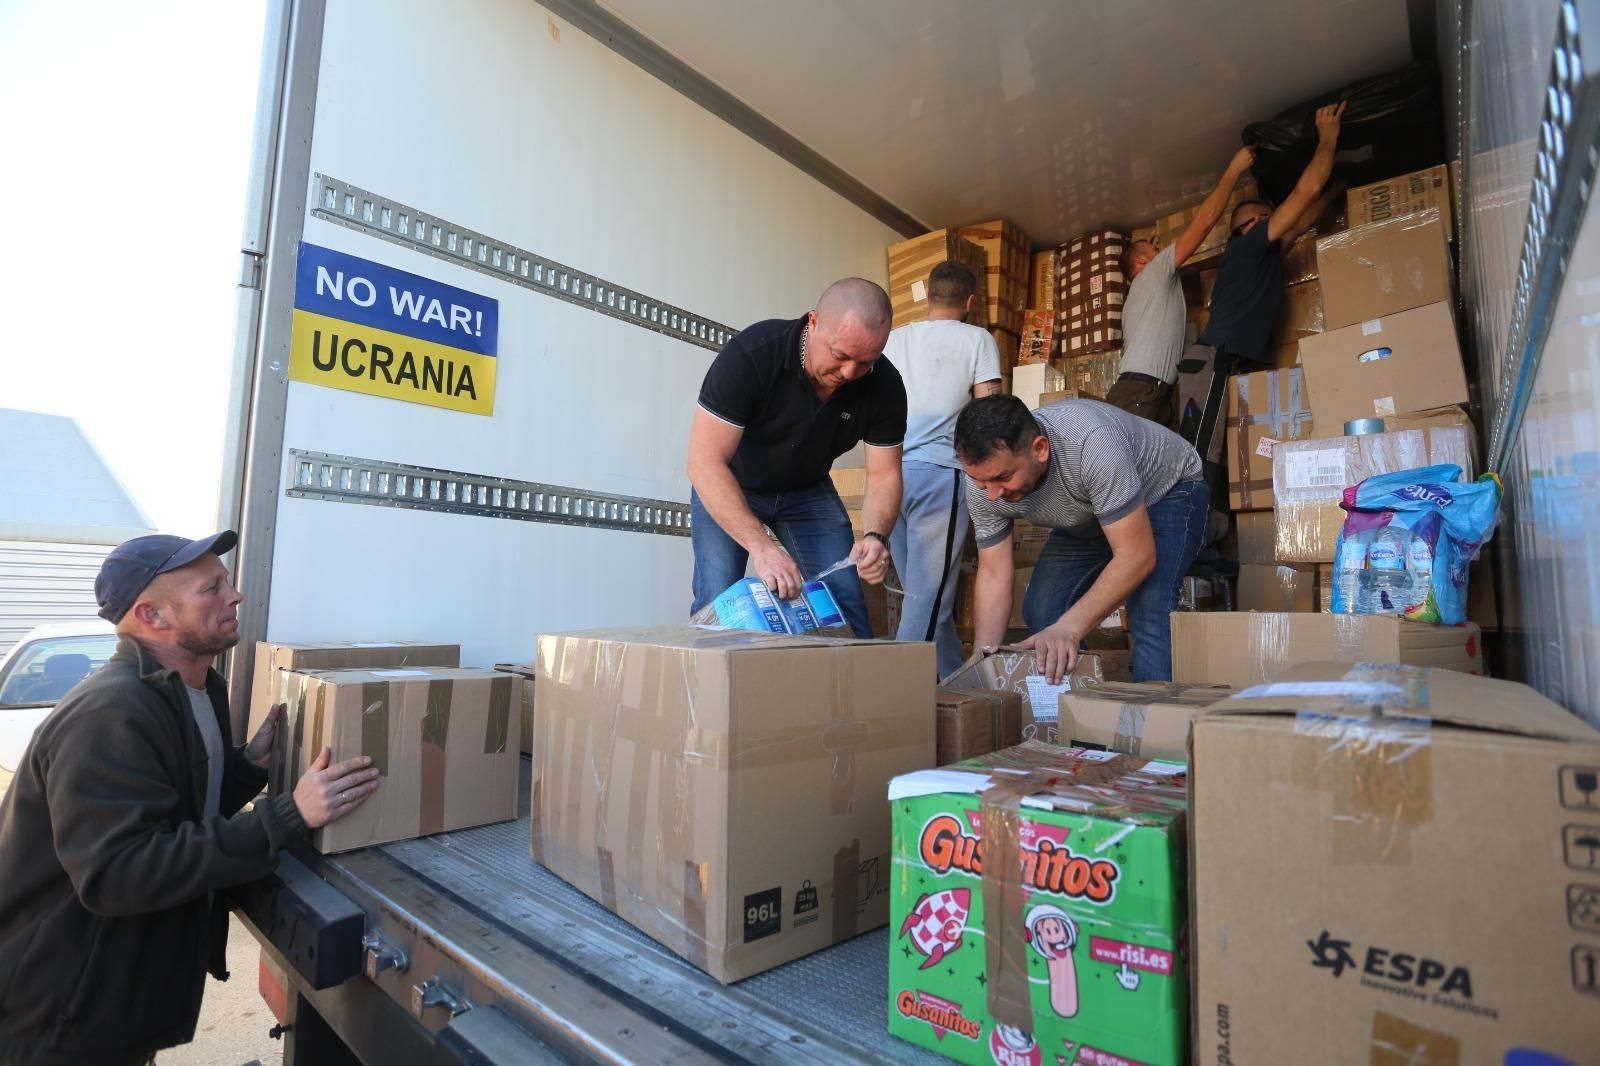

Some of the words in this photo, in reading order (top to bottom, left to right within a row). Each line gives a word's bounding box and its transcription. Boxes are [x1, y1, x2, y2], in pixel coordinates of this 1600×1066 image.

[316, 265, 377, 307] NO
[389, 286, 483, 337] WAR!
[312, 330, 477, 401] UCRANIA
[747, 902, 778, 925] 96L
[1095, 944, 1168, 969] www.risi.es
[1363, 946, 1472, 998] ESPA
[897, 989, 980, 1039] Gusanitos
[1217, 1003, 1232, 1066] pa.com
